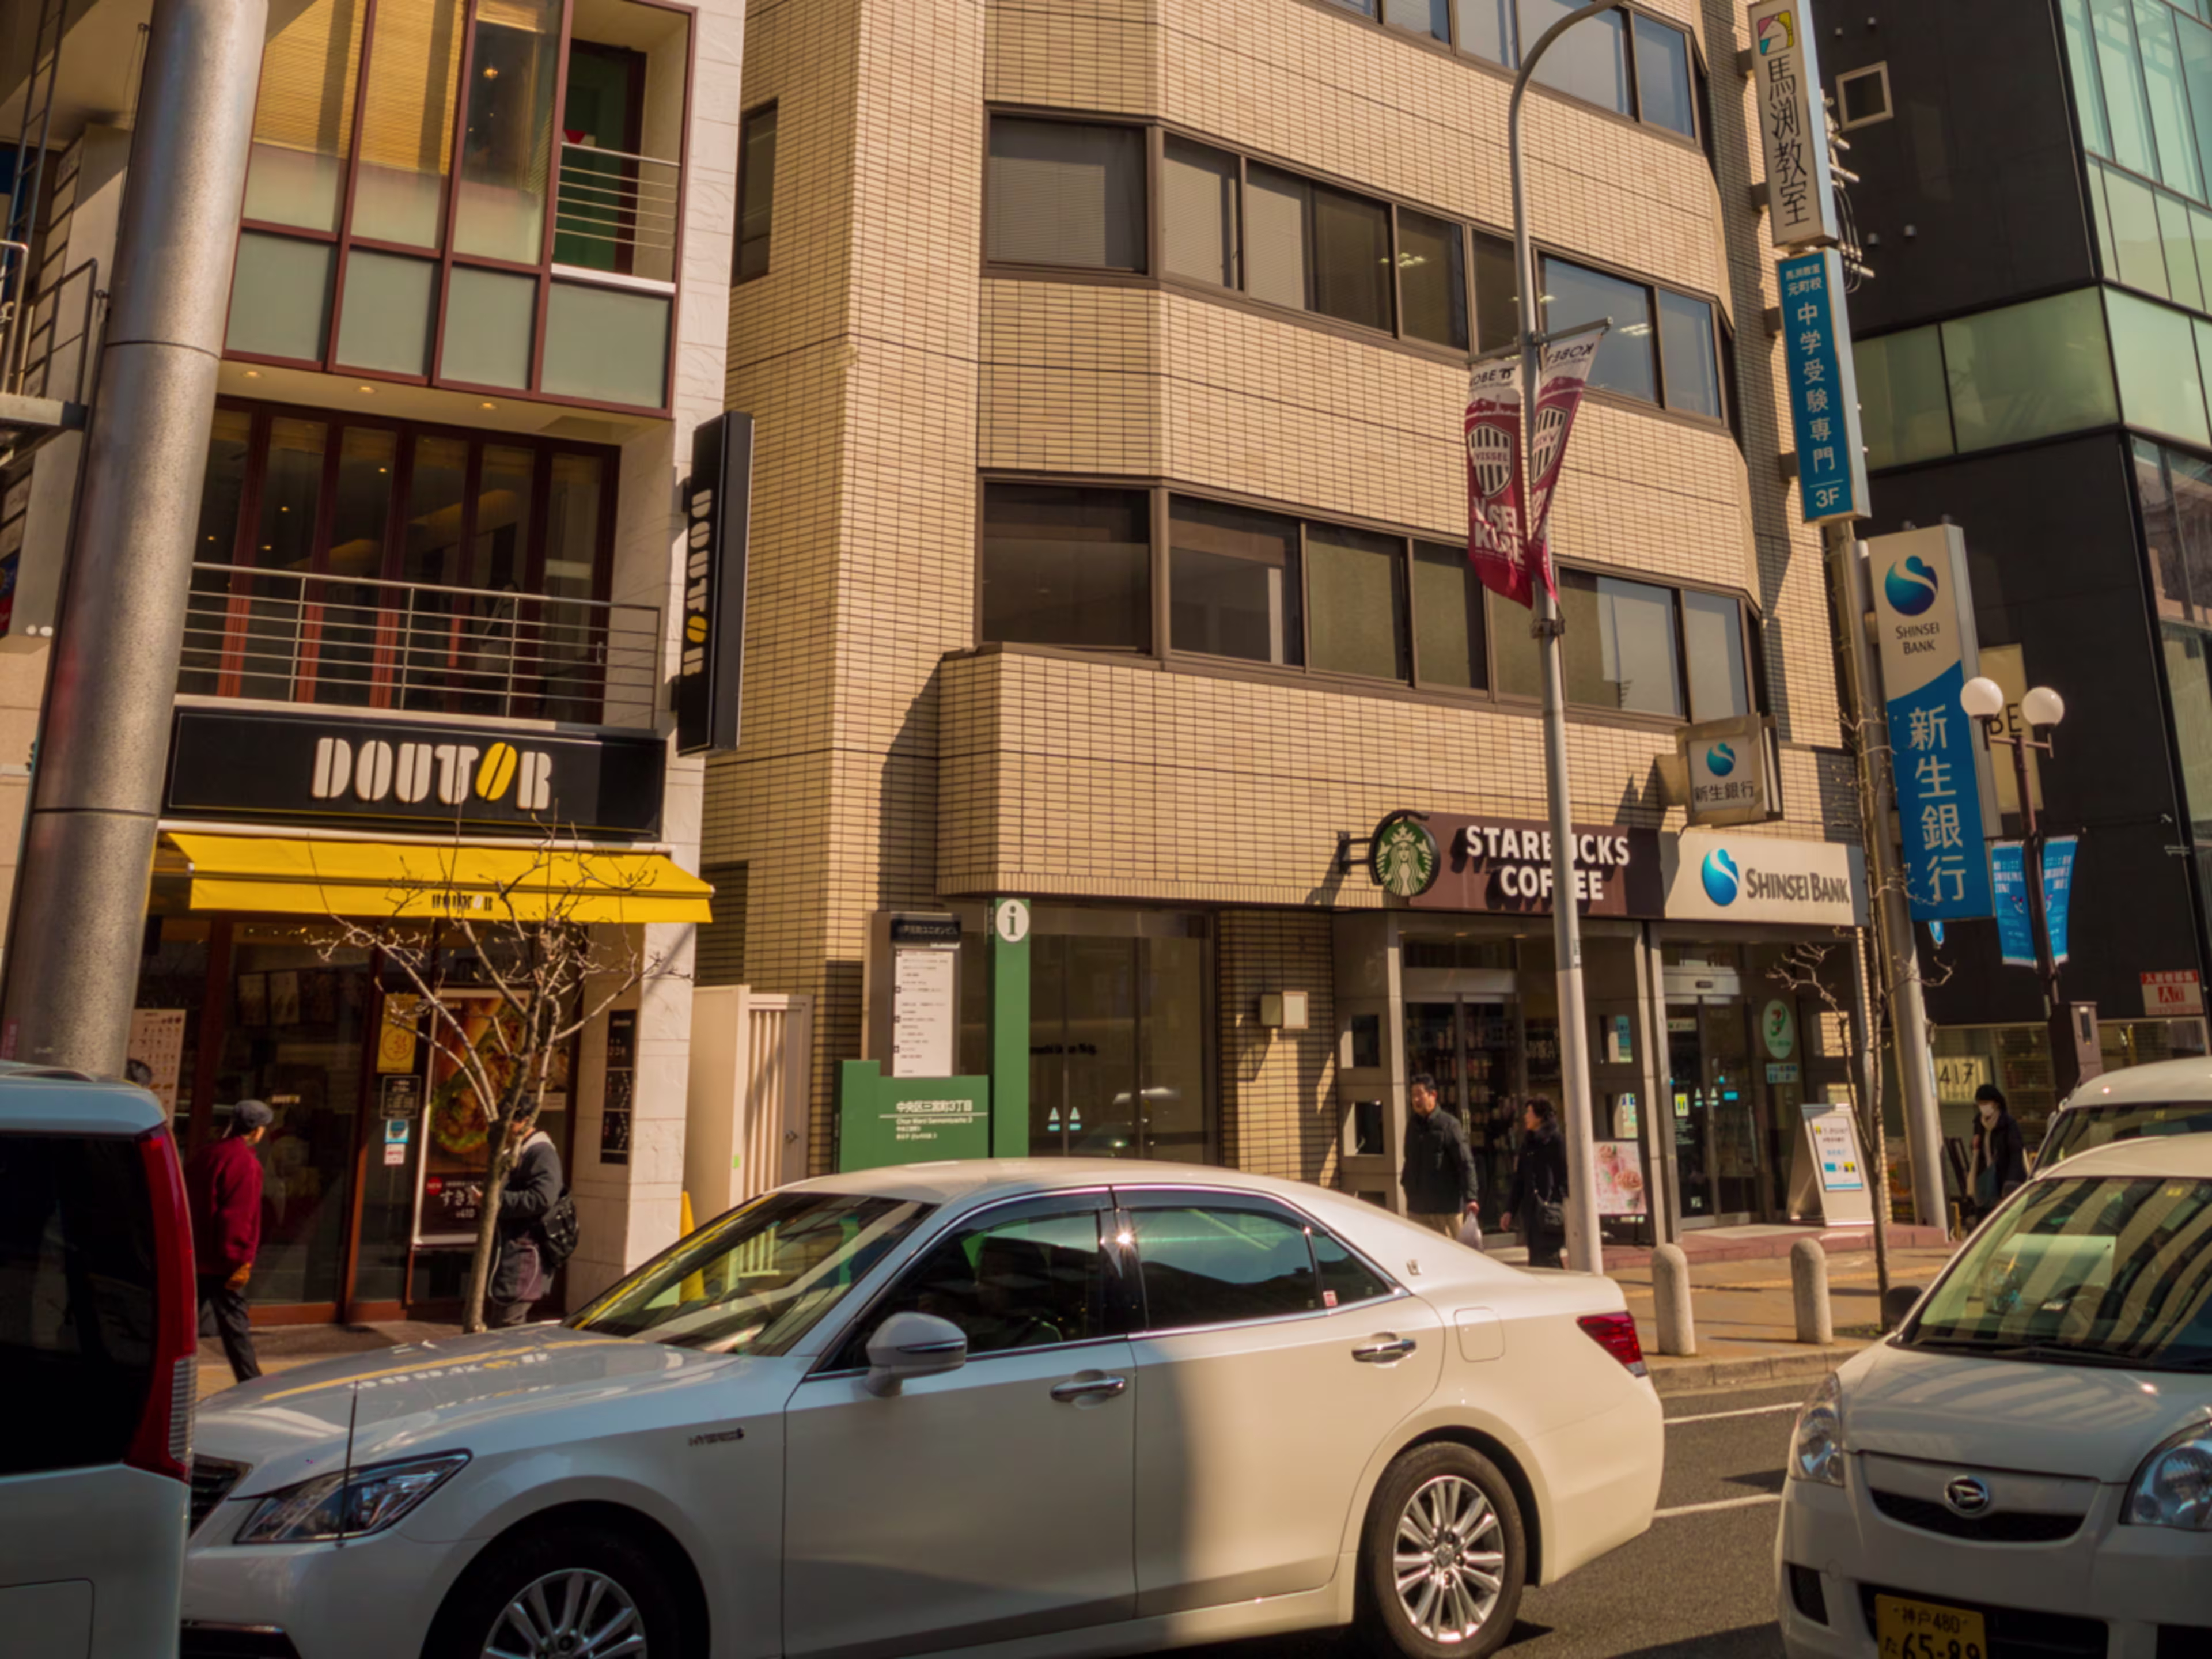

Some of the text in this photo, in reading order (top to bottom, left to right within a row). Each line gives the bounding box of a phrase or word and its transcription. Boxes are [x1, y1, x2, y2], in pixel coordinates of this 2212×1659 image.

[1767, 54, 1809, 227] 馬渕教室
[1797, 302, 1835, 473] 中学受験専門
[1475, 452, 1509, 462] VISSEL
[1815, 487, 1840, 508] 3F
[681, 488, 712, 676] DOUTOR
[1895, 622, 1940, 639] SHINSEI
[1903, 639, 1936, 654] BANK
[312, 737, 552, 810] DOUTOR
[1695, 781, 1753, 802] 新生銀行
[1908, 704, 1967, 902] 新生銀行
[1501, 865, 1604, 900] COFEE
[1745, 868, 1850, 903] SHINSEI BANK
[1938, 1063, 1974, 1085] 417
[1933, 1612, 1960, 1634] 480
